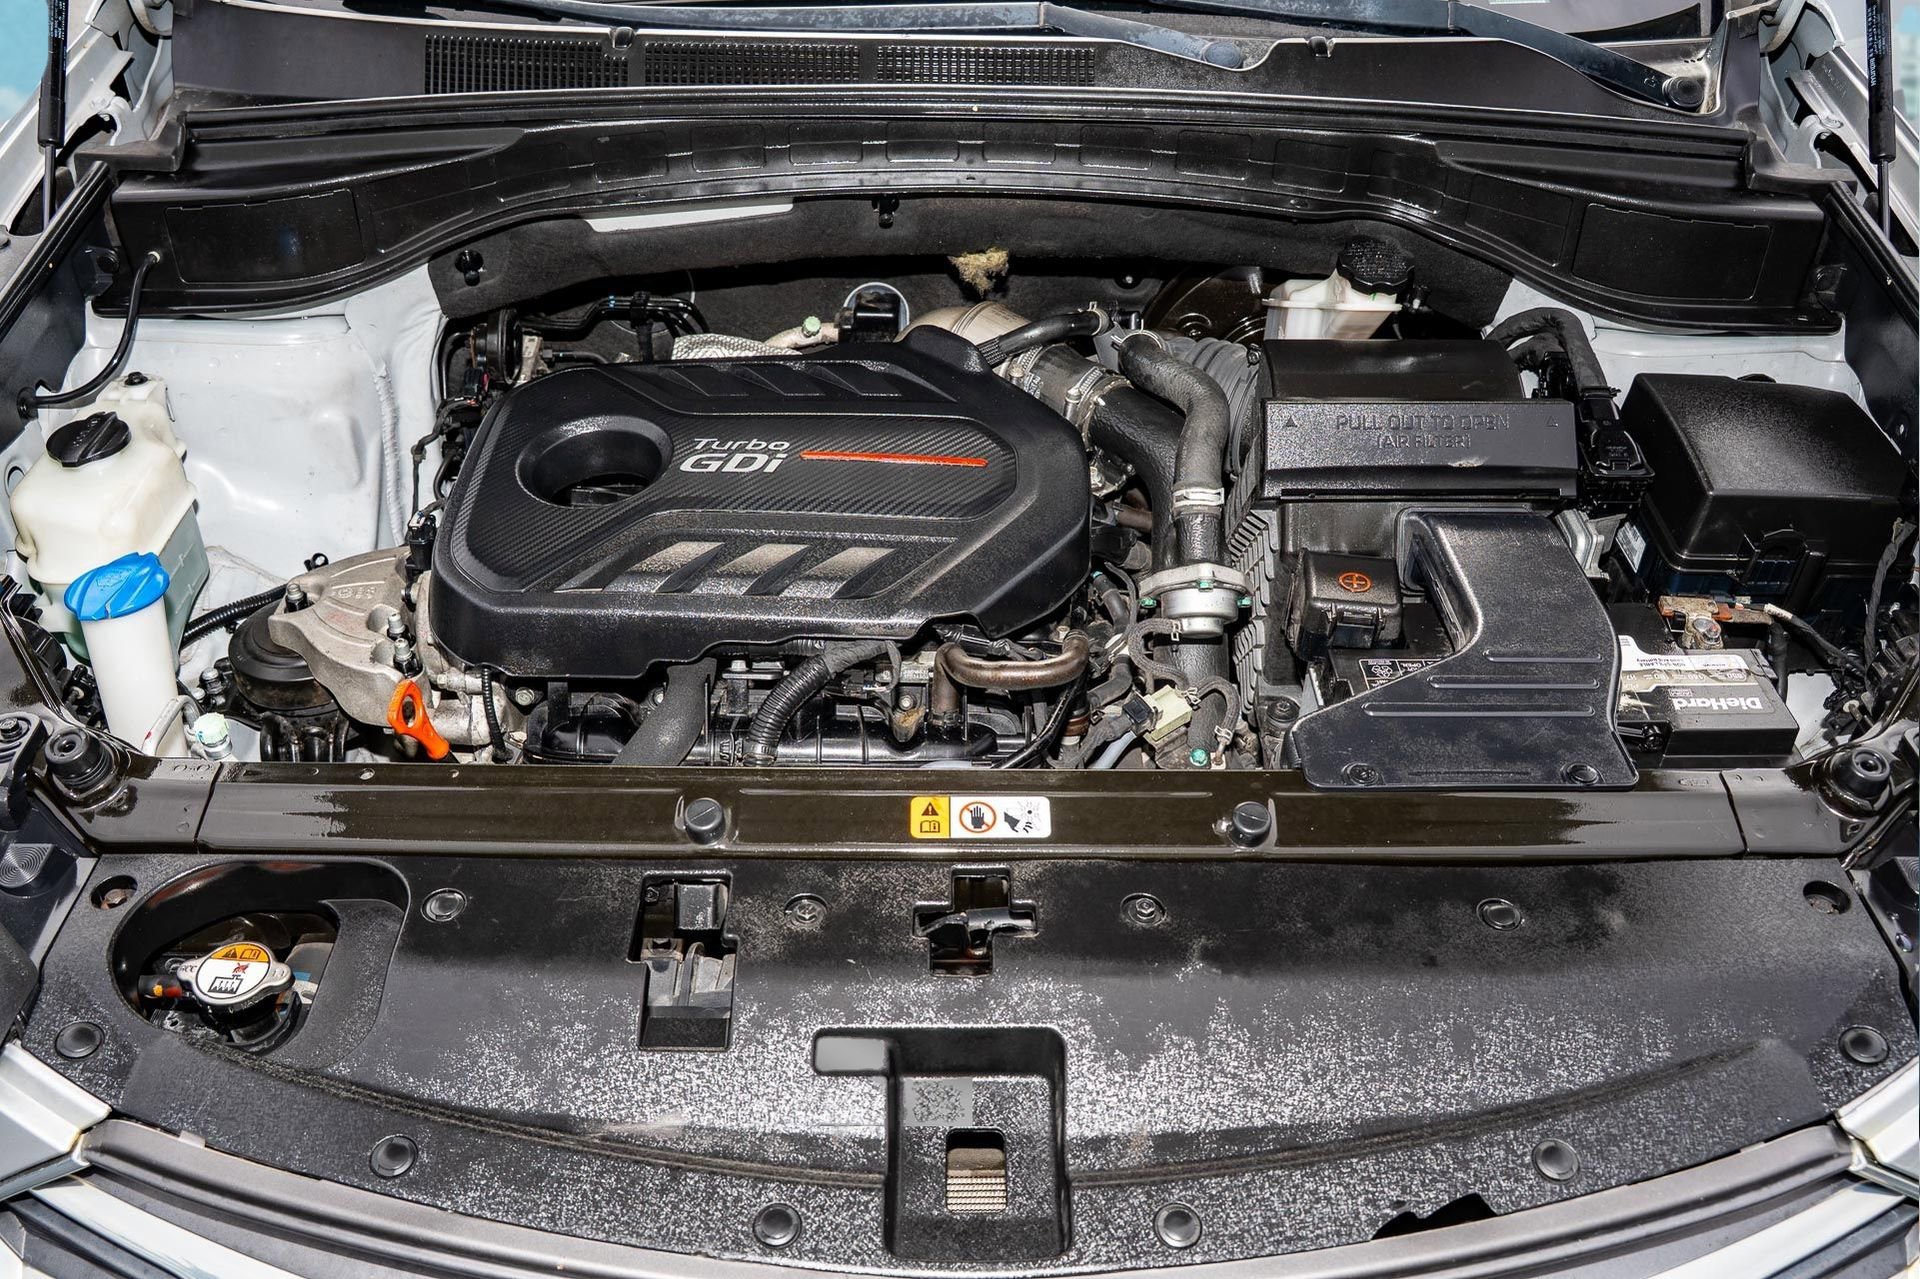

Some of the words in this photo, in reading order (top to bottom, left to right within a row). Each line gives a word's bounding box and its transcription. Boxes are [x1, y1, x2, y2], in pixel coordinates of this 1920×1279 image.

[1336, 414, 1380, 431] PULL
[1387, 414, 1425, 431] OUT
[1431, 414, 1456, 431] TO
[1459, 414, 1511, 431] OPEN
[694, 438, 790, 451] Turbo
[1376, 433, 1409, 449] (AIR
[1414, 433, 1472, 449] FILTER)
[679, 453, 789, 473] GDi
[1672, 697, 1763, 710] DieHard
